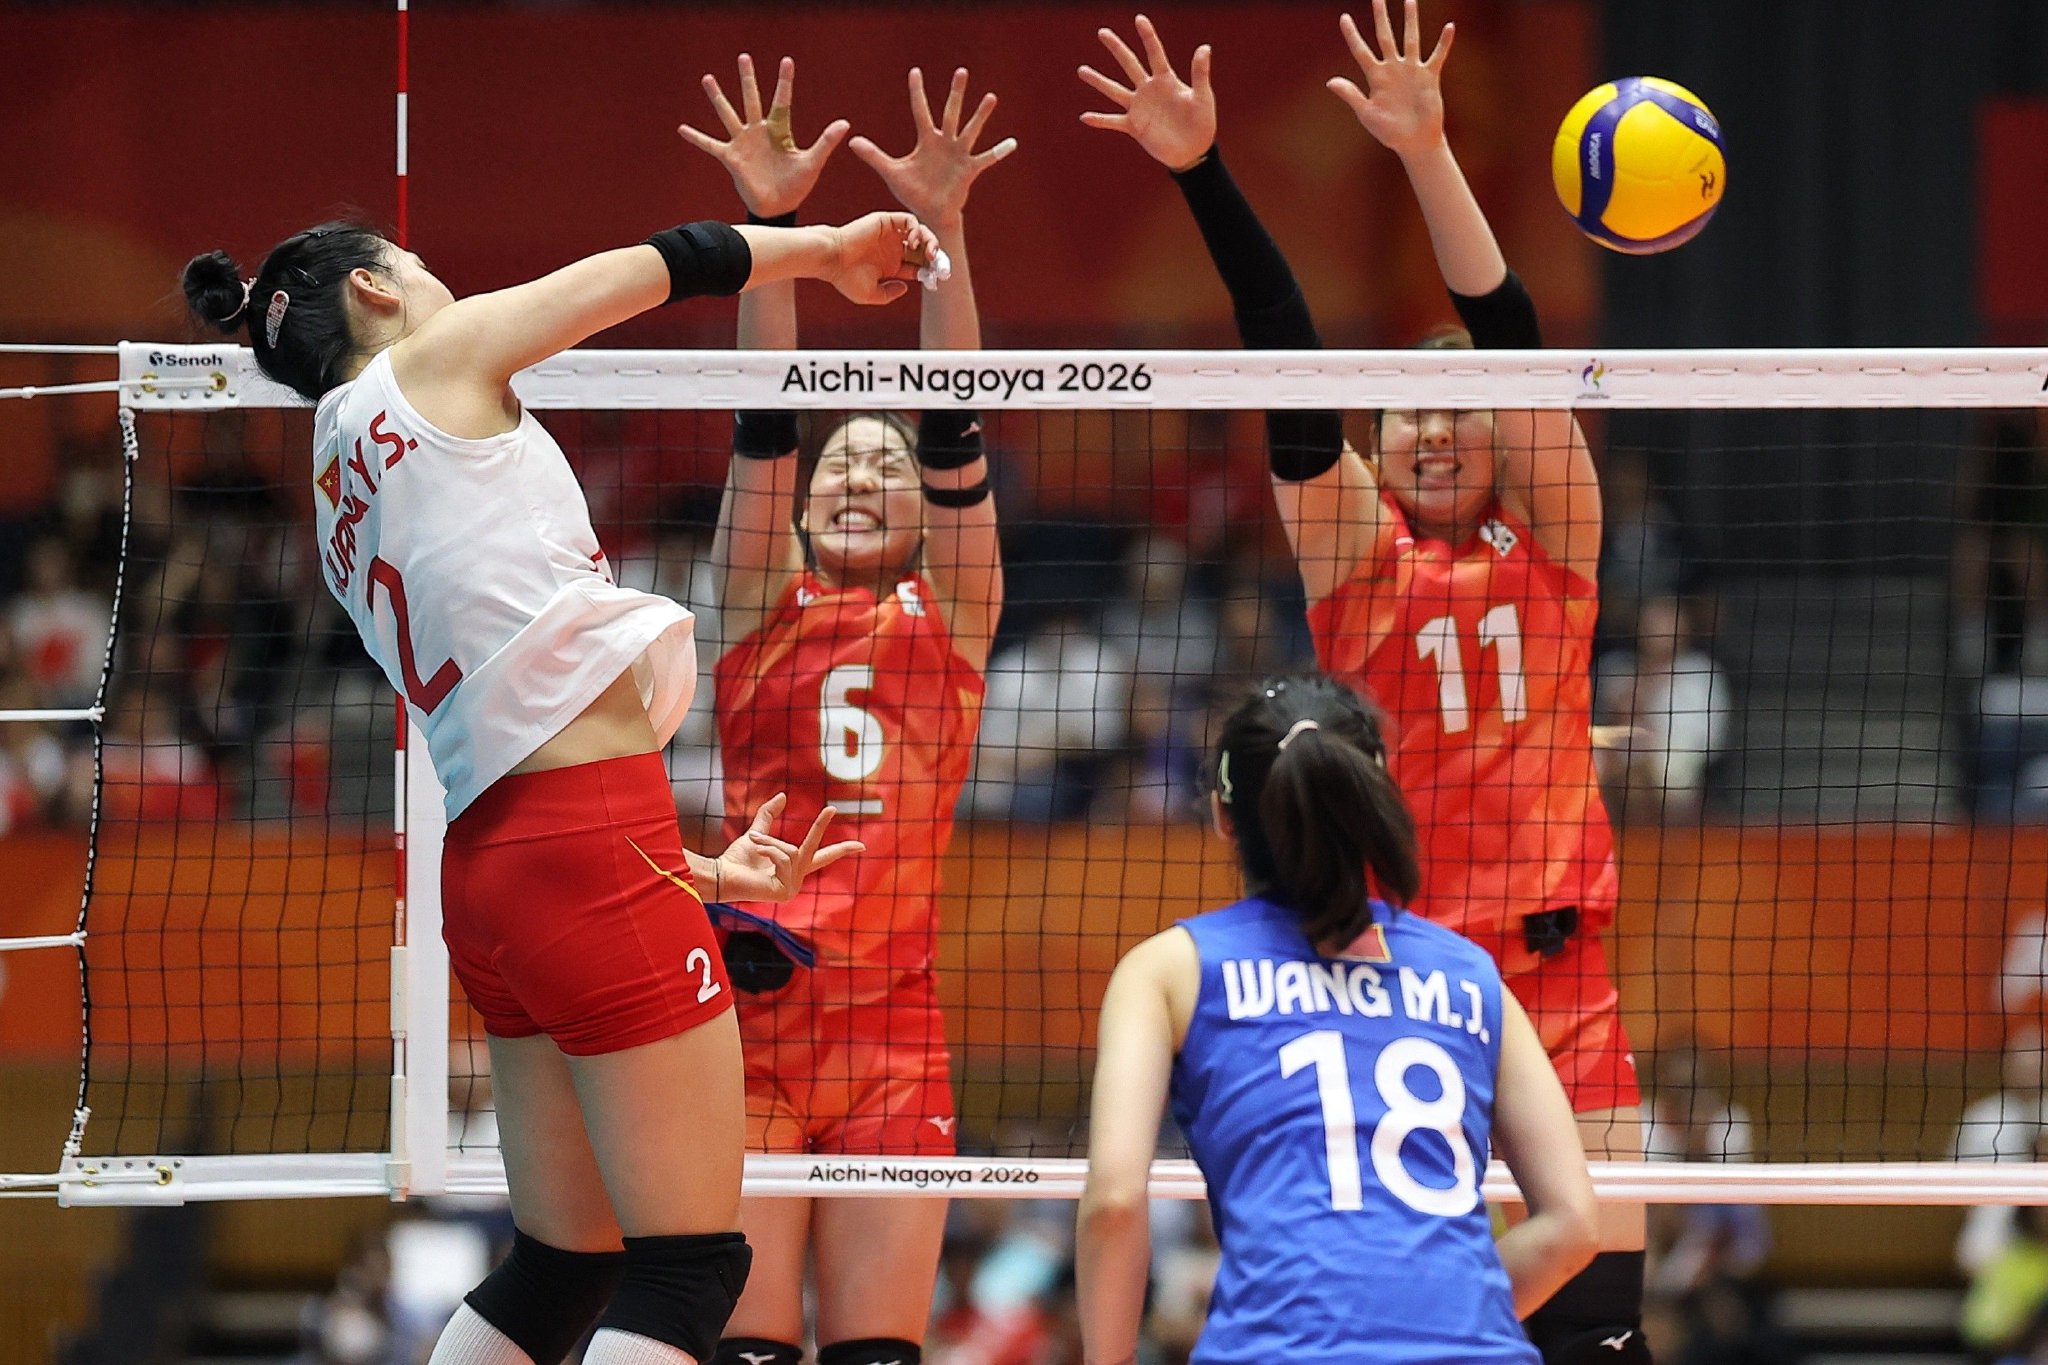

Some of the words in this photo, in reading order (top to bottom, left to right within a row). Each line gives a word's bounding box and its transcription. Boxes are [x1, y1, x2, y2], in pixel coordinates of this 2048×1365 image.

[166, 353, 223, 367] Senoh
[781, 361, 1044, 401] Aichi-Nagoya
[1057, 362, 1153, 393] 2026
[366, 554, 464, 717] 2
[1415, 602, 1528, 735] 11
[819, 662, 884, 782] 6
[686, 947, 722, 1004] 2
[1220, 956, 1393, 1021] WANG
[1398, 964, 1491, 1045] M.J.
[1277, 1028, 1479, 1218] 18
[807, 1163, 972, 1189] Aichi-Nagoya
[979, 1166, 1040, 1184] 2026
